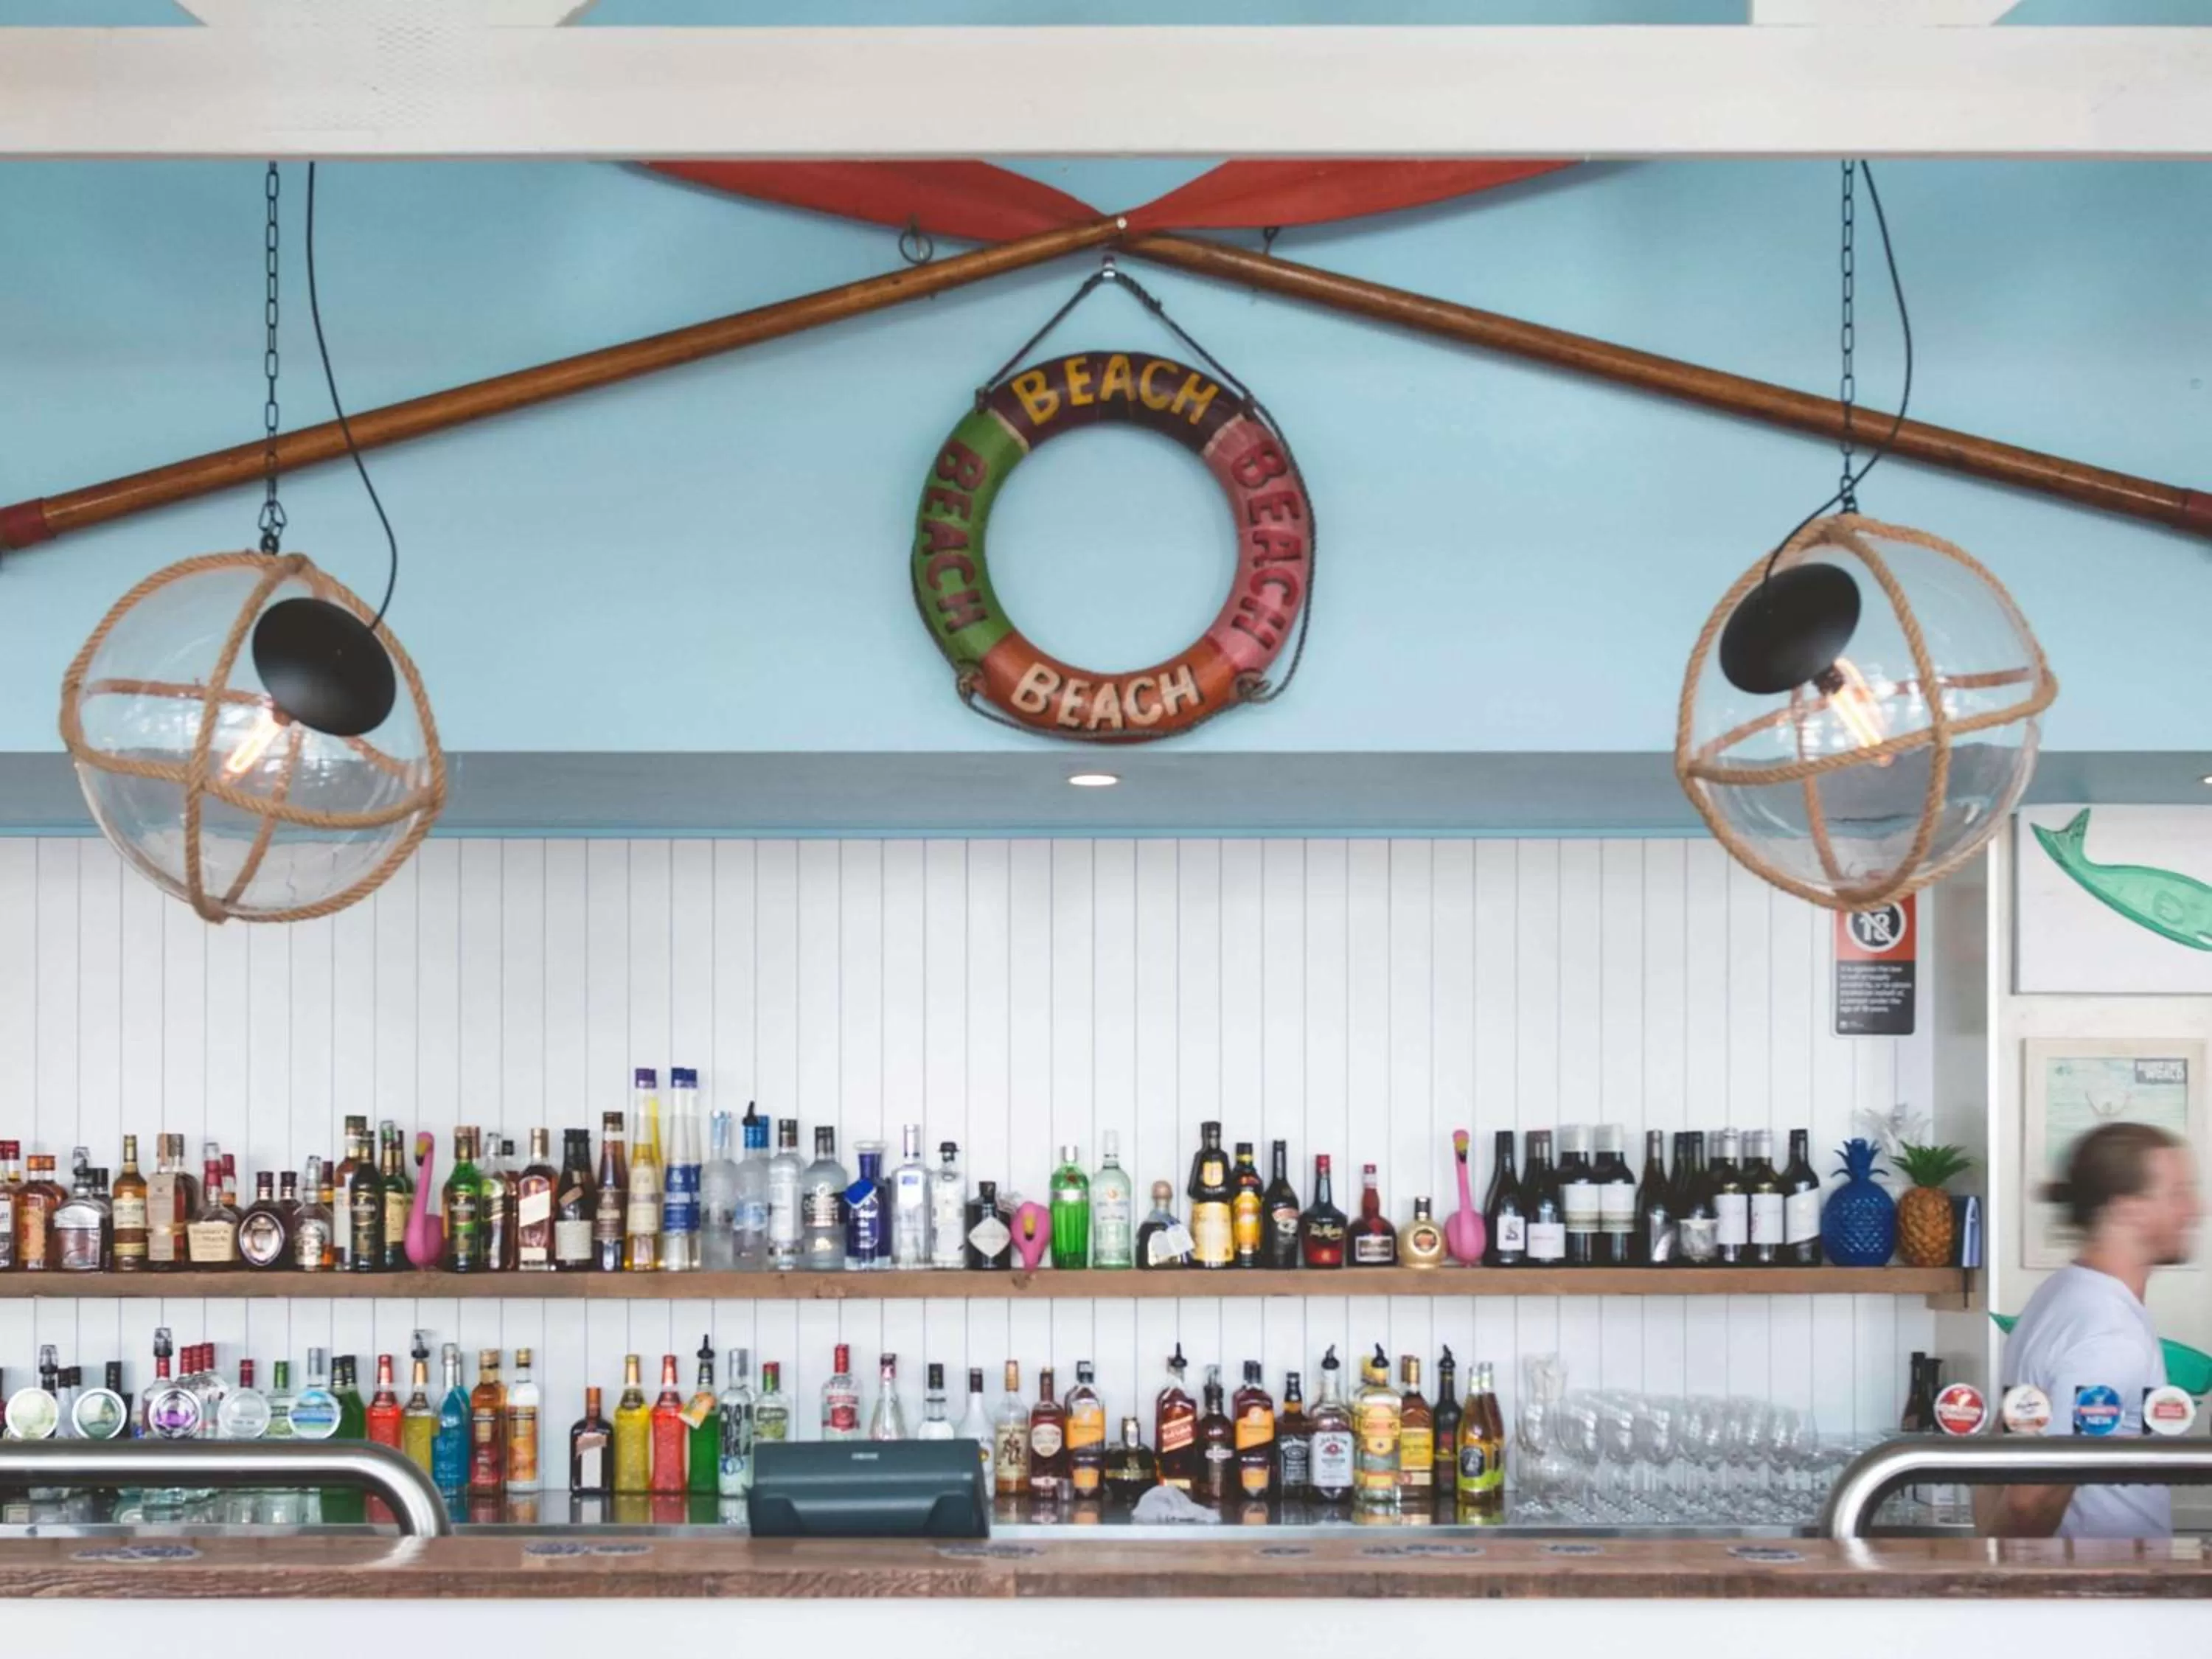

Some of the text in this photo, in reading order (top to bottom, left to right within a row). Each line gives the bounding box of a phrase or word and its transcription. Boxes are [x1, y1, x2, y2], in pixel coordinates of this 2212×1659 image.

[1011, 353, 1219, 425] BEACH
[922, 438, 989, 634] BEACH
[1231, 440, 1303, 651] BEACH
[1010, 661, 1201, 730] BEACH
